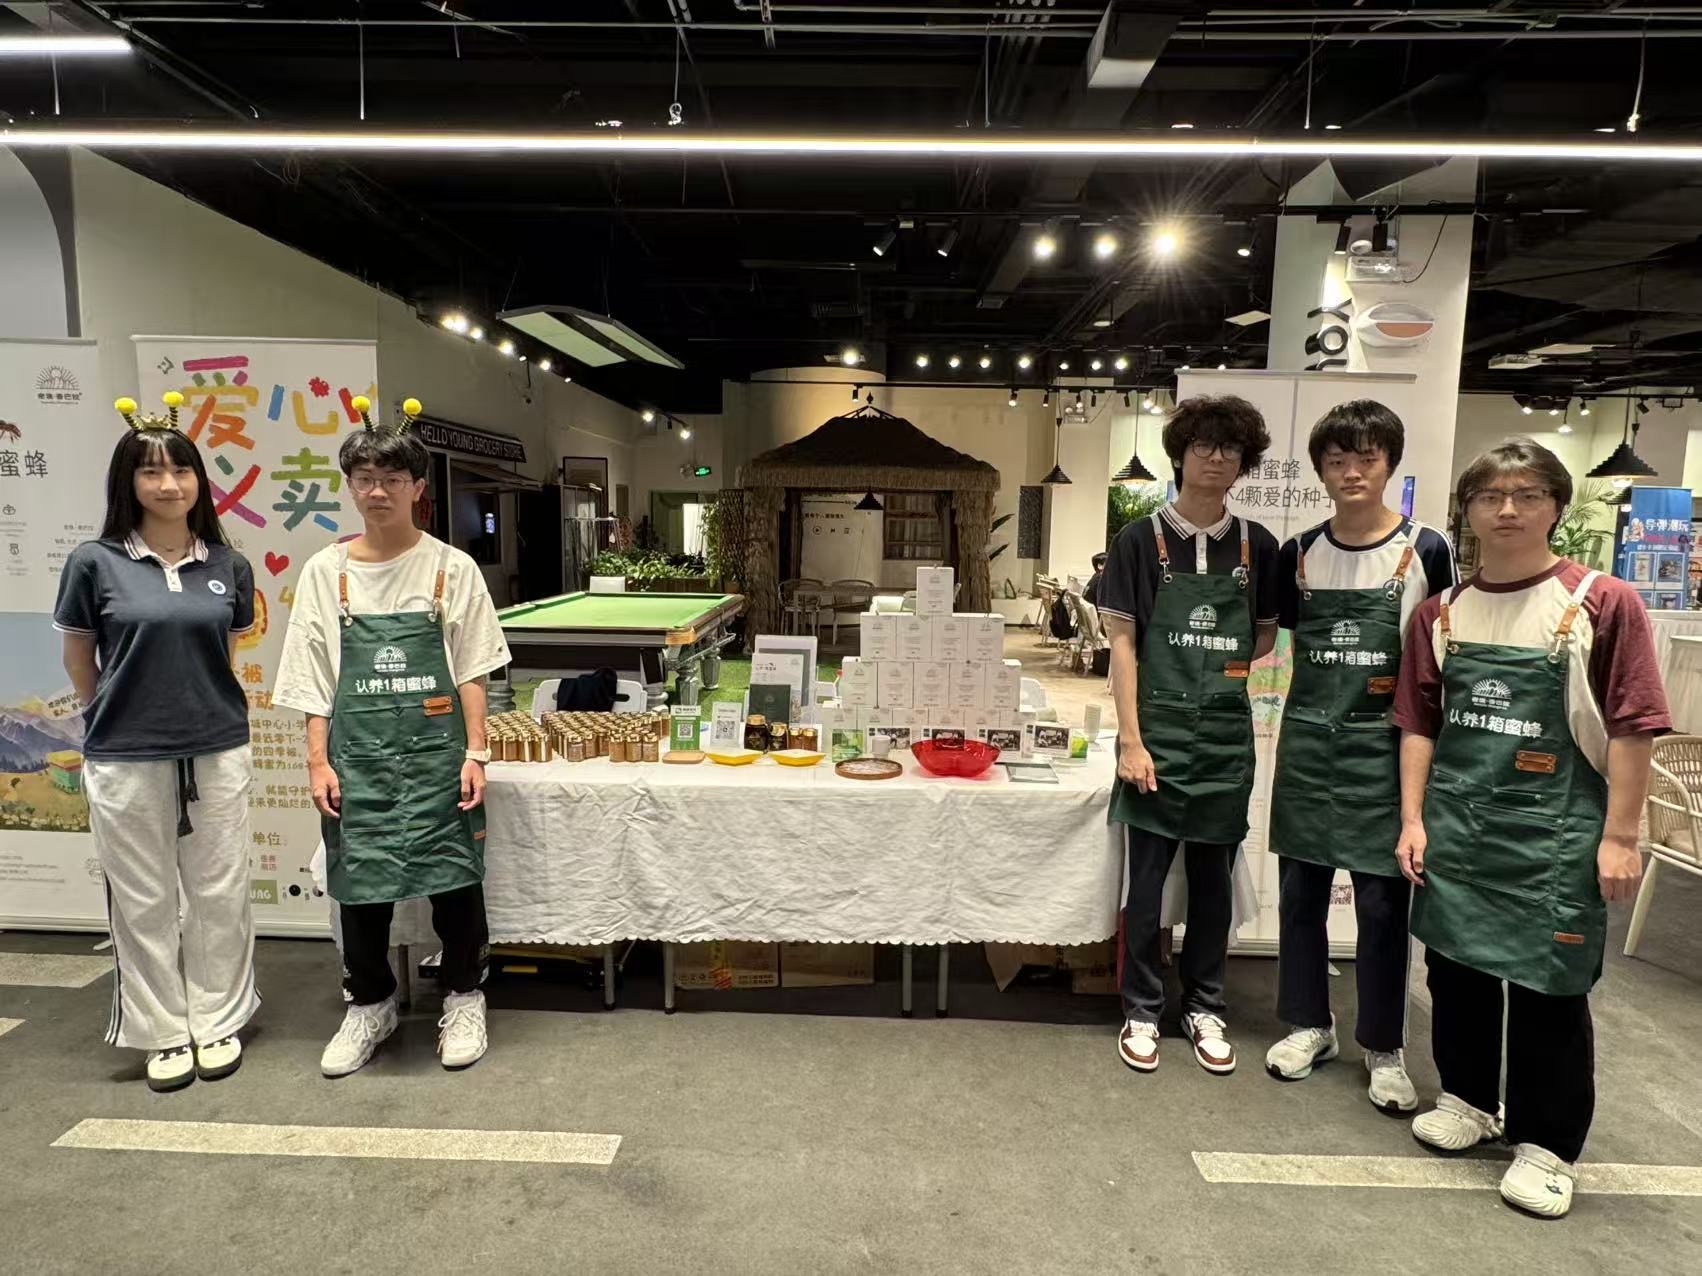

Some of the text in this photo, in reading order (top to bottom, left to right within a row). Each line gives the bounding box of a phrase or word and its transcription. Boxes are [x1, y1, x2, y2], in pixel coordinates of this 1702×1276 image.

[181, 355, 362, 450] 爱心
[420, 423, 448, 445] HELLO
[448, 430, 474, 450] YOUNG
[0, 449, 49, 478] 蜜蜂
[204, 446, 342, 532] 义卖
[1167, 631, 1239, 652] 认养1箱蜜蜂
[1309, 650, 1388, 666] 认养1箱蜜蜂
[355, 675, 437, 693] 认养1箱蜜蜂
[1449, 708, 1543, 738] 认养1箱蜜蜂
[247, 797, 315, 808] 来更灿烂的
